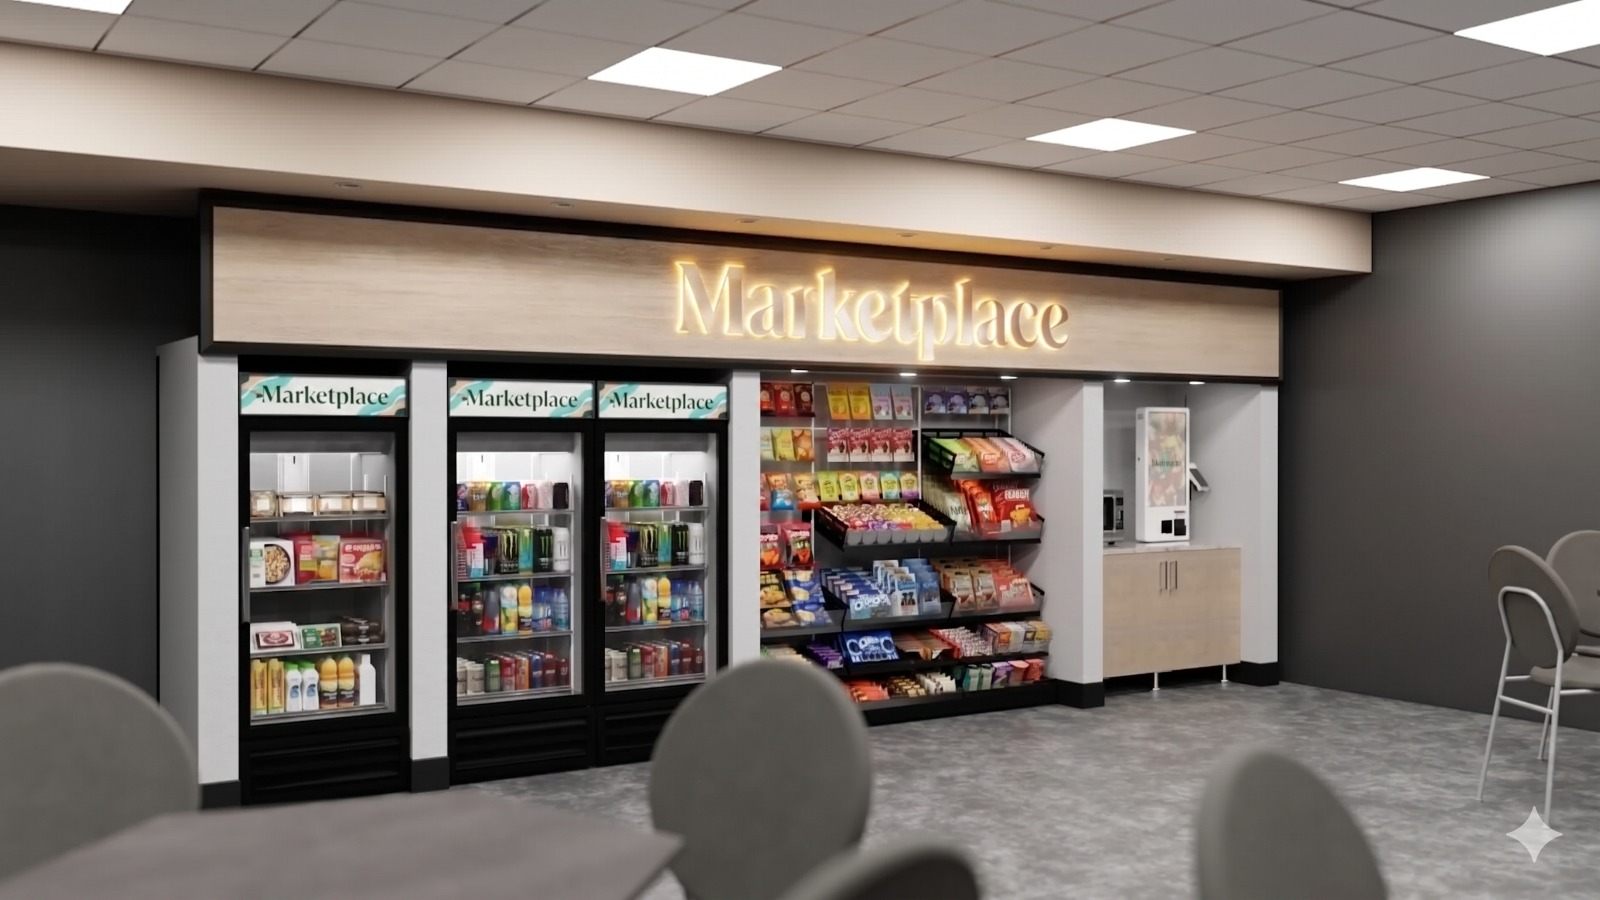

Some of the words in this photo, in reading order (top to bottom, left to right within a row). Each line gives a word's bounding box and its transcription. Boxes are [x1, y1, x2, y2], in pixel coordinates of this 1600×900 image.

[674, 260, 1070, 361] Marketplace
[262, 385, 388, 409] Marketplace
[466, 389, 578, 412] Marketplace
[612, 391, 714, 414] Marketplace
